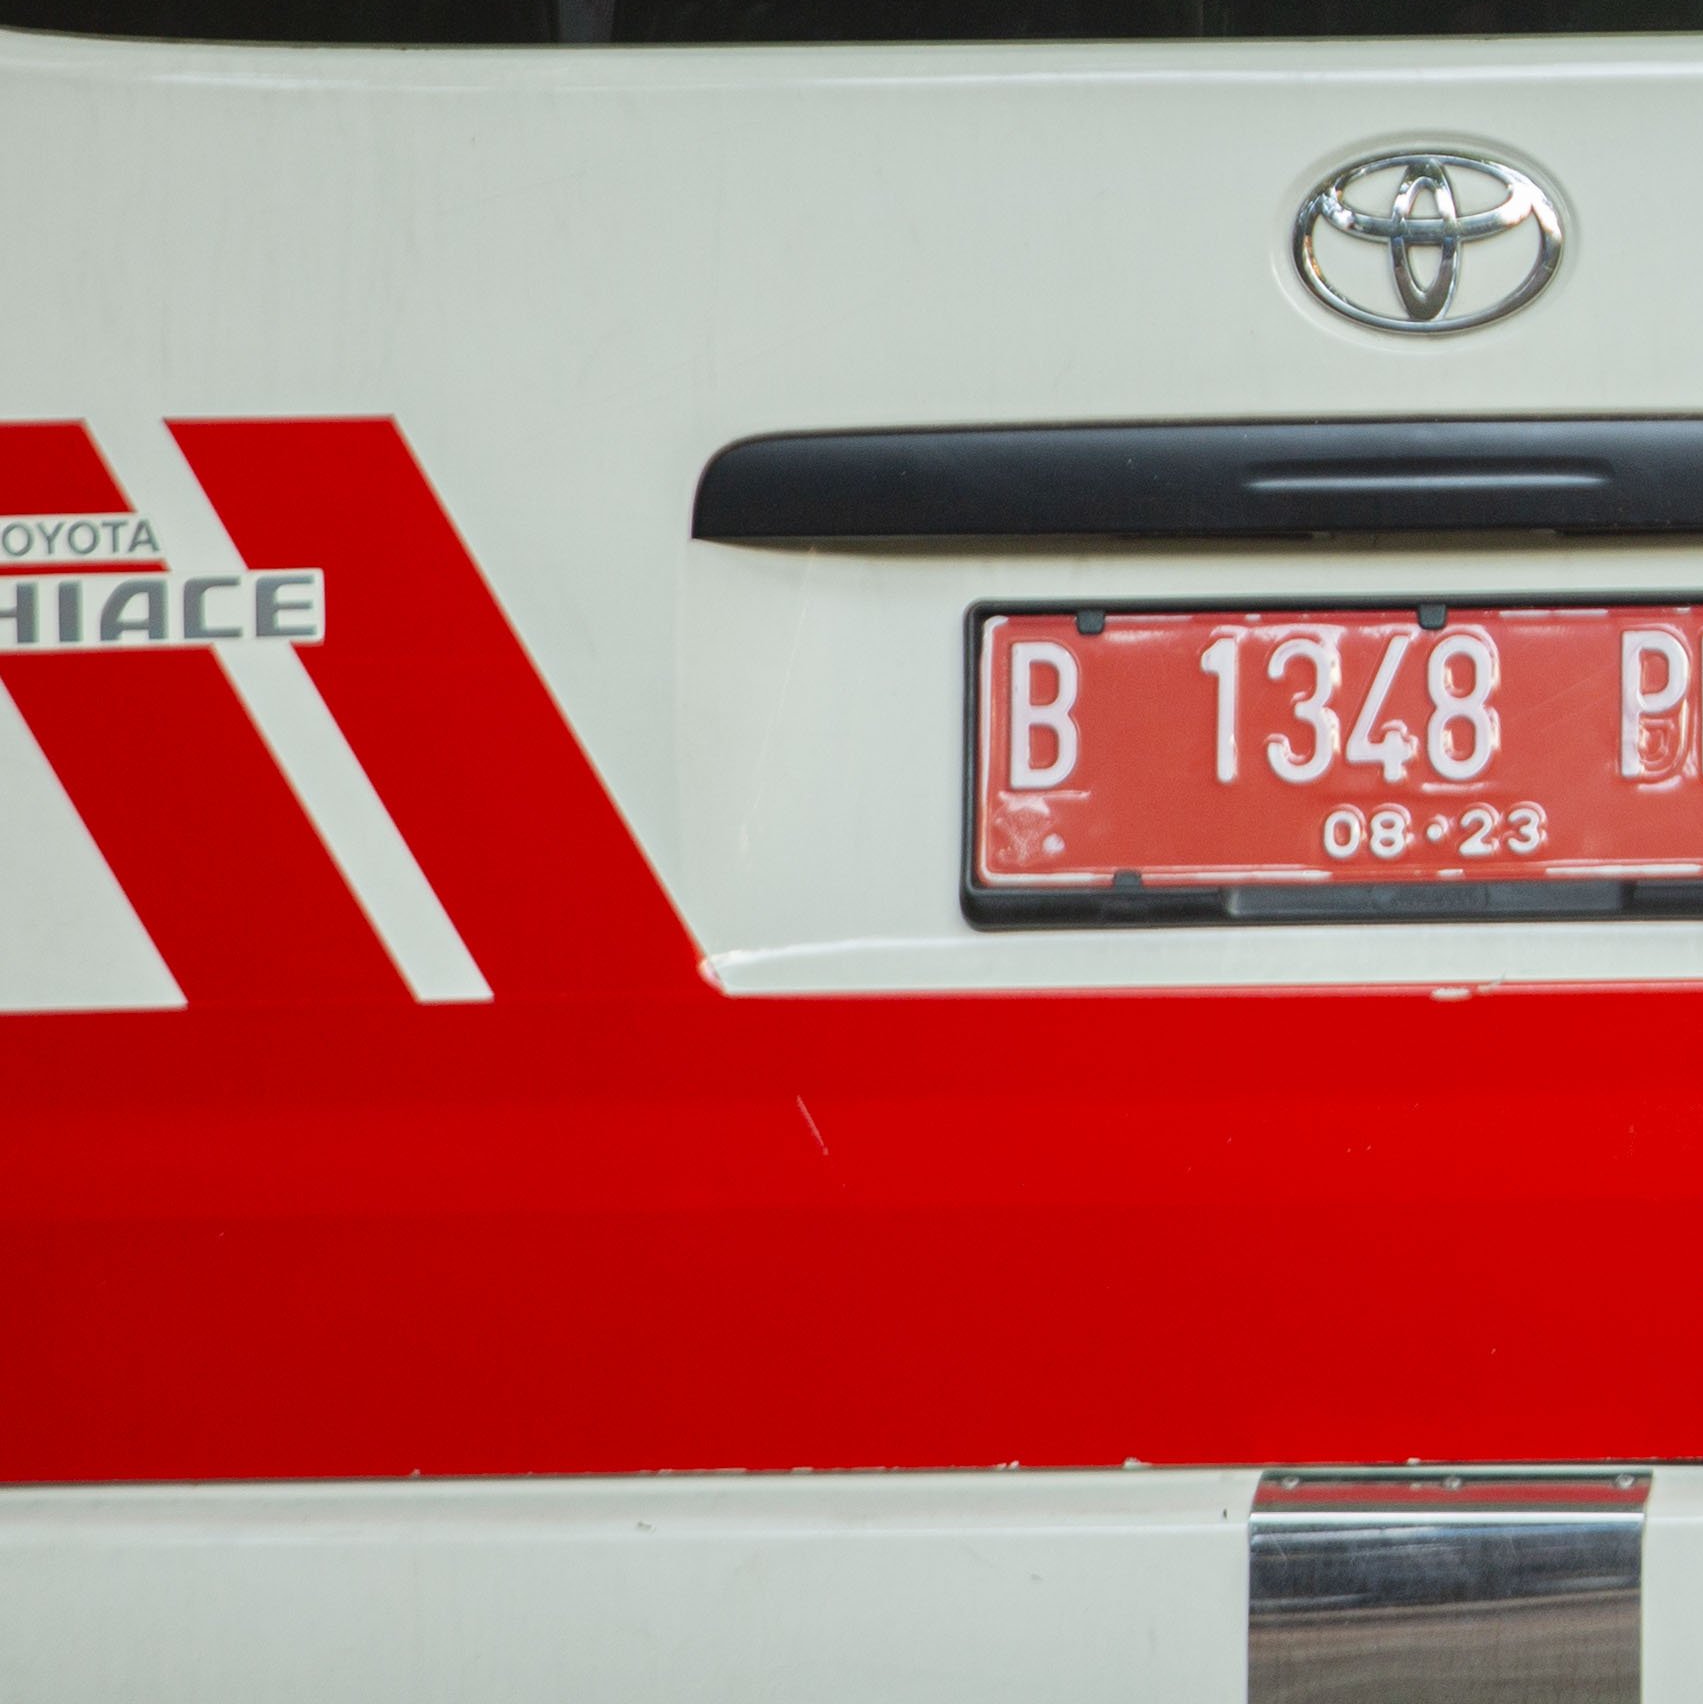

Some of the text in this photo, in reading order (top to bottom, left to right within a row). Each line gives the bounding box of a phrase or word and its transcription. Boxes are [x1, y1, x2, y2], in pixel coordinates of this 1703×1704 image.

[2, 519, 160, 557] OYOTA
[1009, 641, 1079, 790] B
[1201, 633, 1500, 784] 1348
